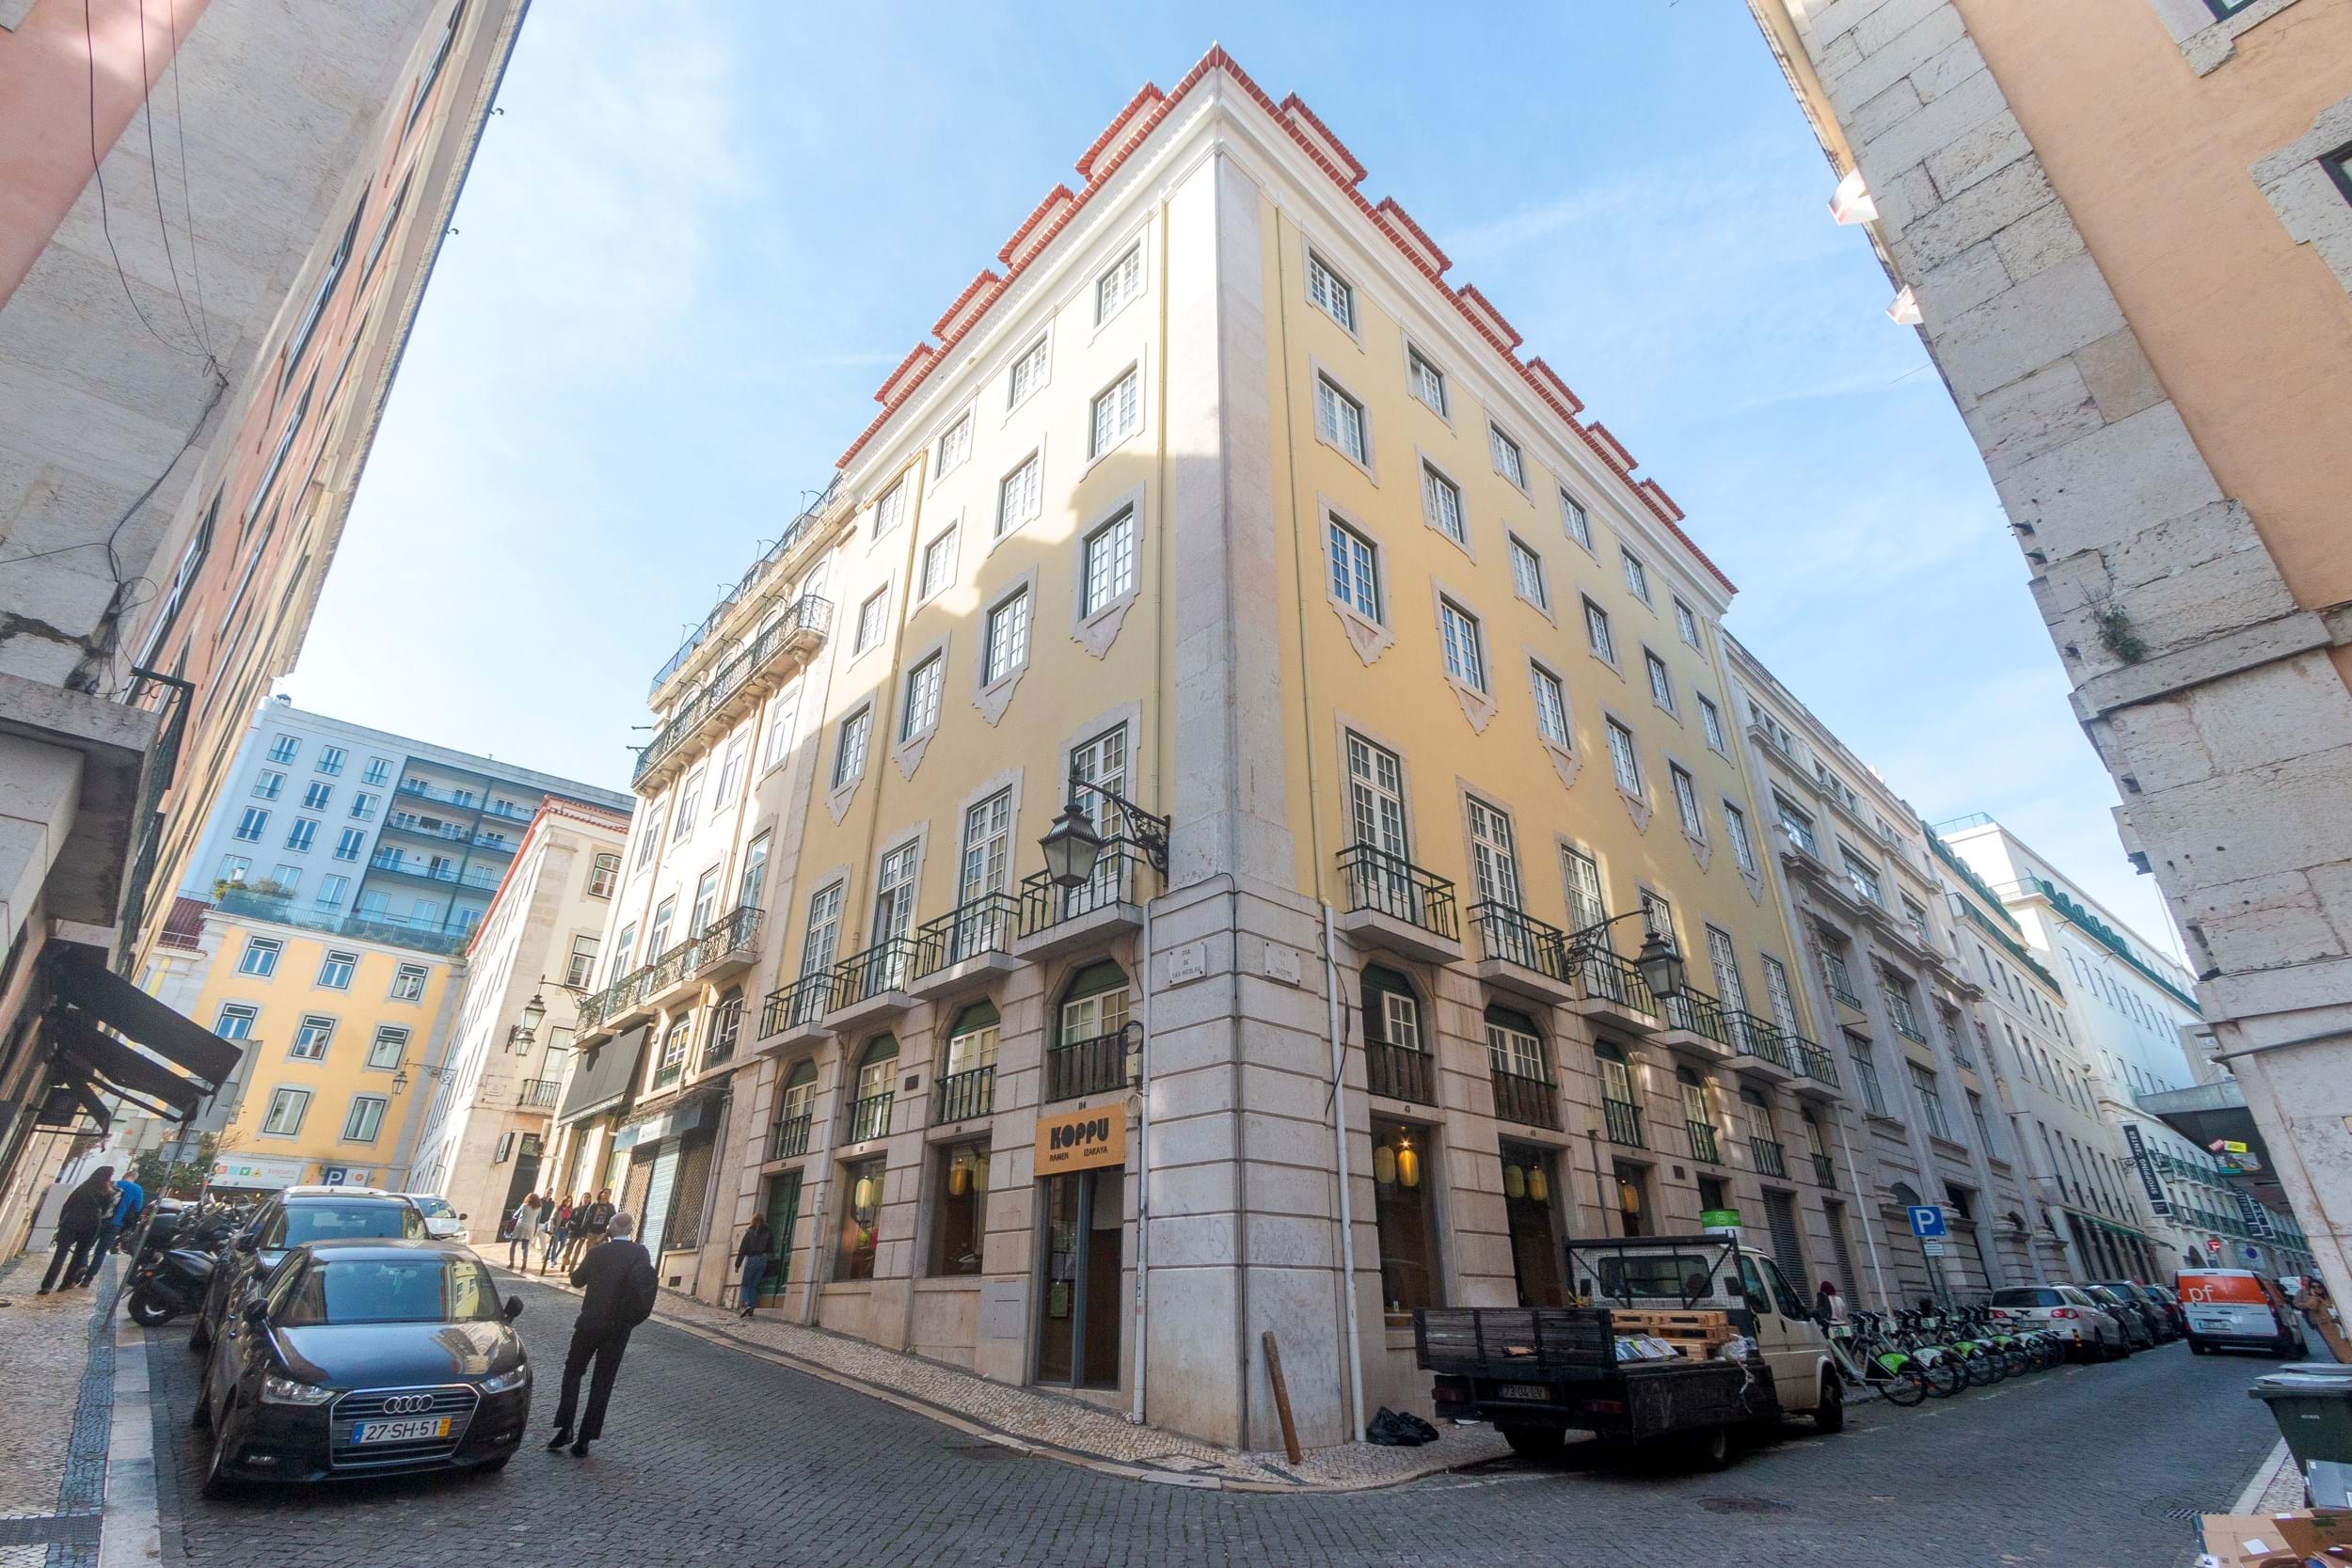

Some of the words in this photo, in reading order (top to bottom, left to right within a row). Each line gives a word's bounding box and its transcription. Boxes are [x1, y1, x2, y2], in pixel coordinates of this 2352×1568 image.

[1050, 1117, 1109, 1150] KOPPU
[2128, 1131, 2143, 1158] CENTER
[1049, 1152, 1070, 1162] RAMEN
[1083, 1146, 1108, 1157] IZAKAYA
[2138, 1158, 2158, 1195] SHOPPING
[1915, 1209, 1935, 1233] P
[2188, 1284, 2214, 1307] pf
